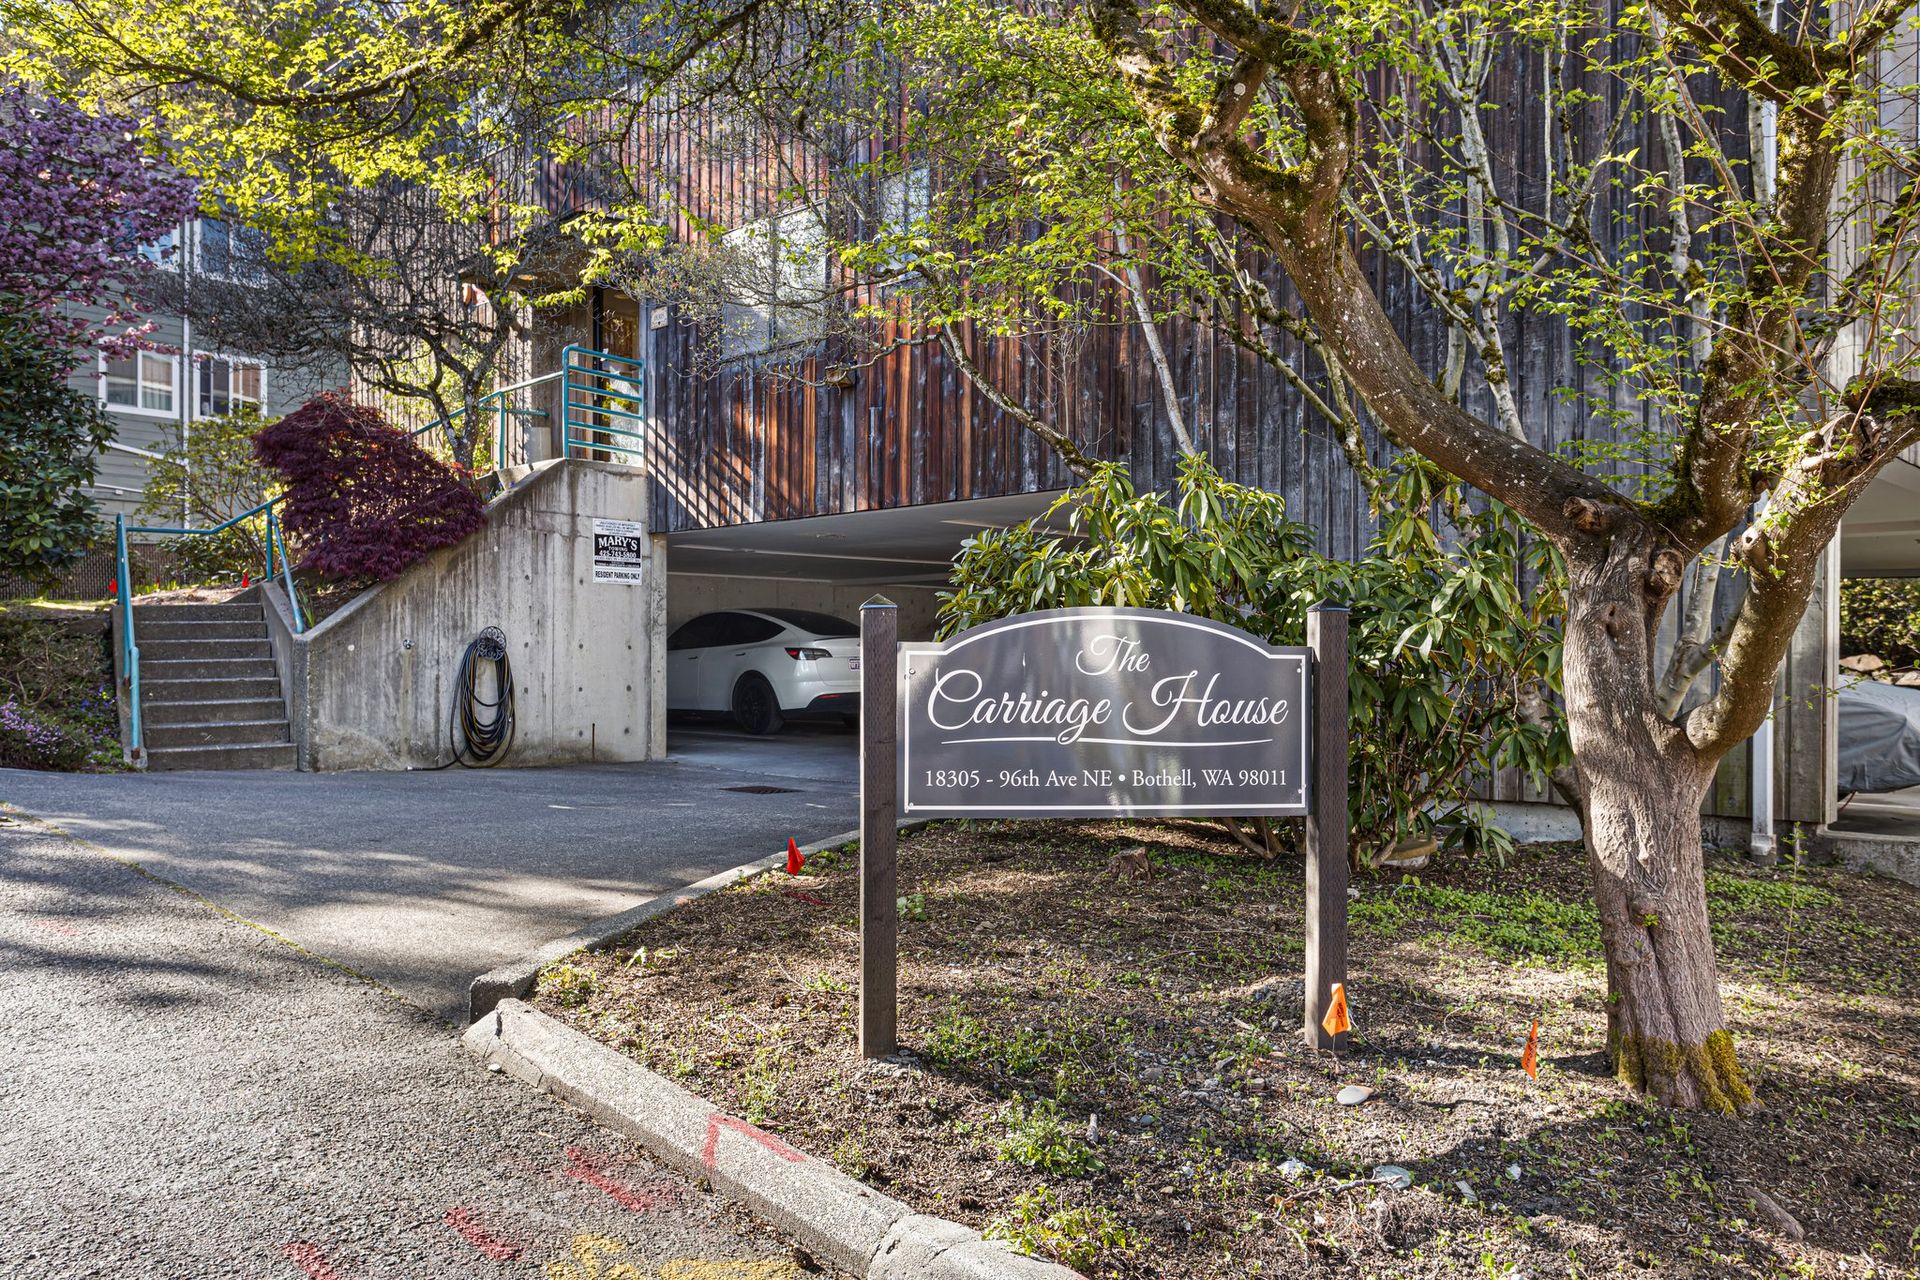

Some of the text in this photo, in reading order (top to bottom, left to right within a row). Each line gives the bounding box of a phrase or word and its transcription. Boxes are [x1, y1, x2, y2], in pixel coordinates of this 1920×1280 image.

[598, 536, 638, 551] MARY'S
[614, 572, 630, 580] PARKING
[1076, 635, 1150, 676] The
[927, 668, 1289, 746] Carriage House
[926, 770, 980, 788] 18305
[999, 769, 1040, 788] 96th
[1044, 770, 1078, 788] Ave
[1082, 769, 1114, 788] NE
[1132, 768, 1197, 790] Bothell,
[1201, 769, 1235, 787] WA
[1238, 769, 1287, 787] 98011
